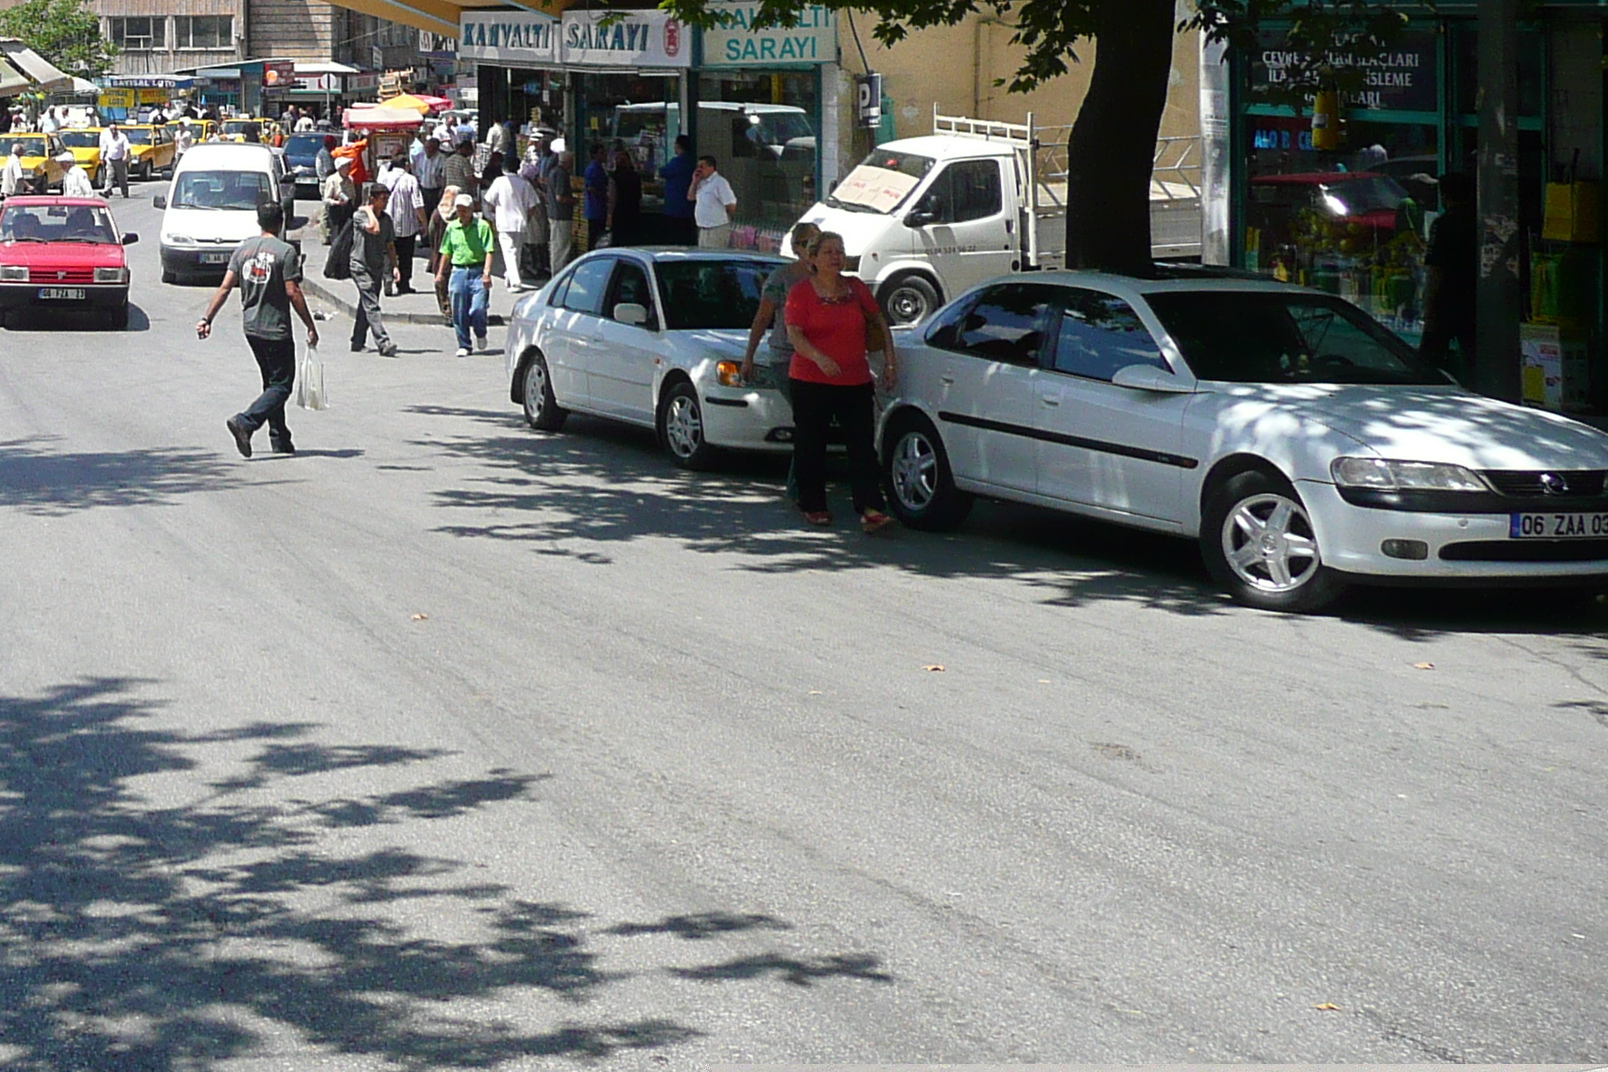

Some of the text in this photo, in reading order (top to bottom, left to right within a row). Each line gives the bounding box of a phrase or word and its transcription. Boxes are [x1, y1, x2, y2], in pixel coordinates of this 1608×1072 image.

[462, 22, 550, 49] KAHVALTI
[565, 21, 649, 52] SARAYI
[725, 36, 817, 61] SARAYI
[151, 79, 176, 88] LOTO
[1521, 515, 1545, 535] 06
[1554, 514, 1586, 536] ZAA
